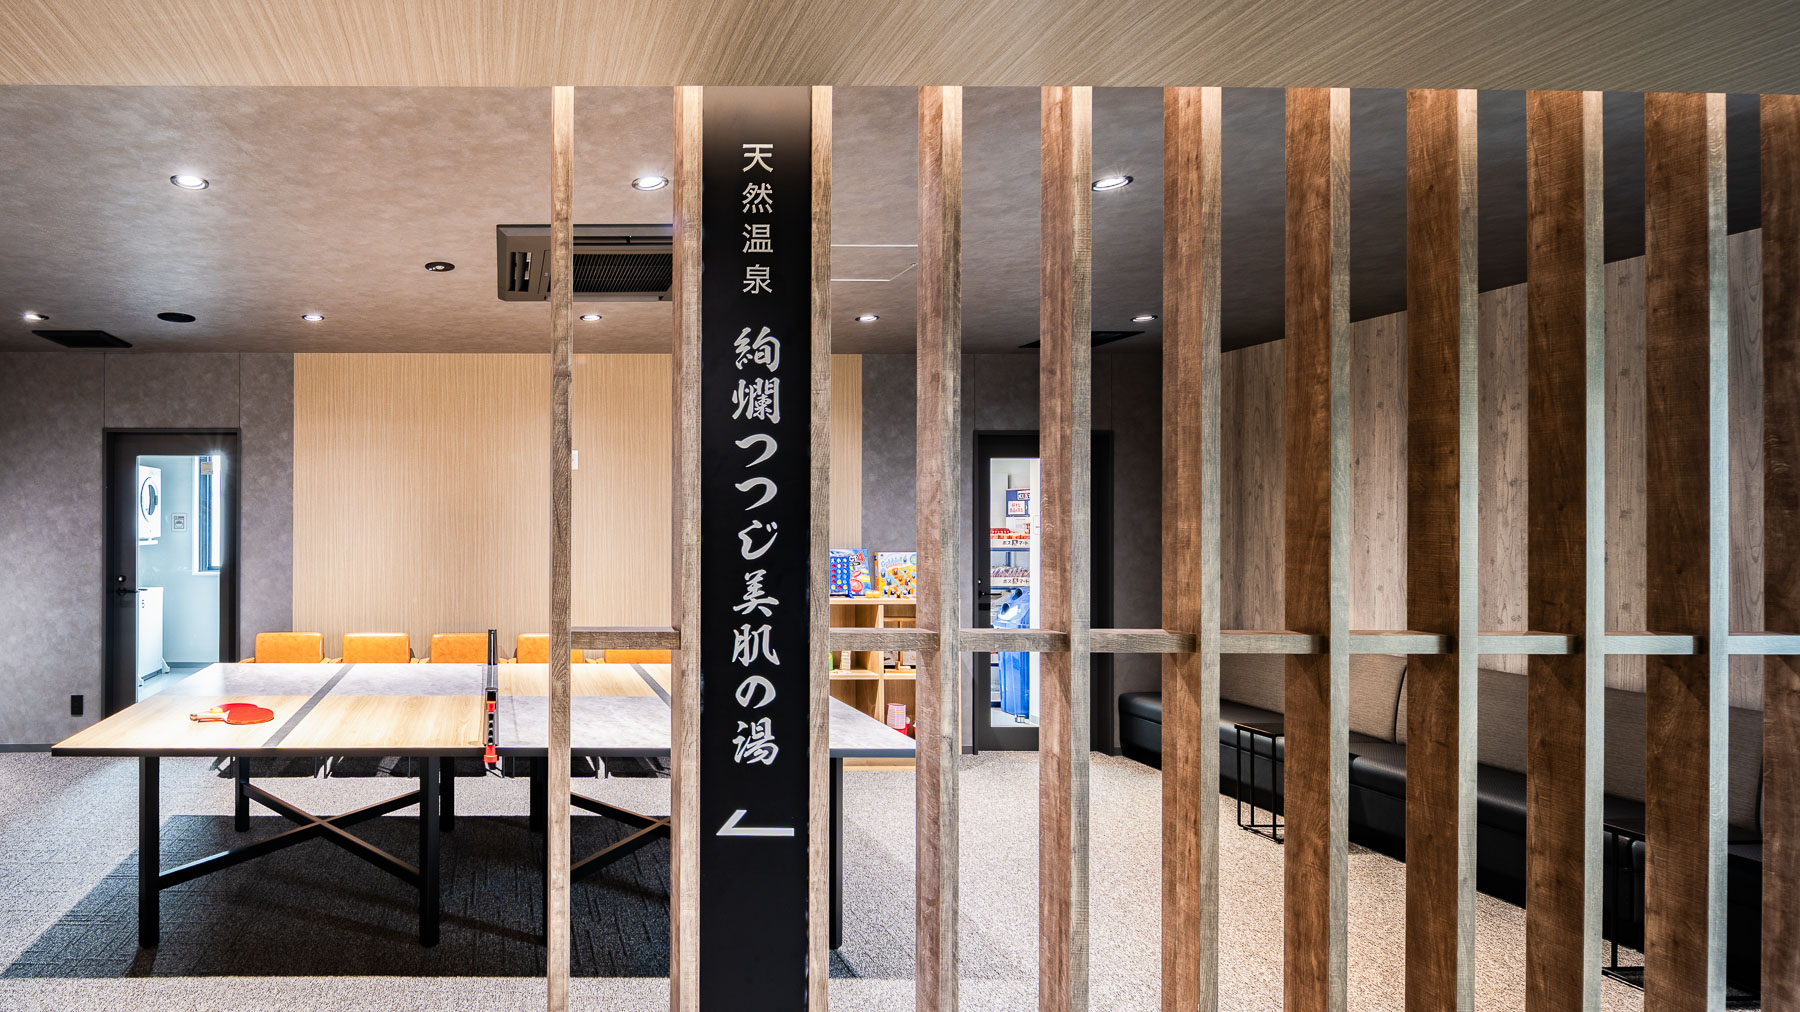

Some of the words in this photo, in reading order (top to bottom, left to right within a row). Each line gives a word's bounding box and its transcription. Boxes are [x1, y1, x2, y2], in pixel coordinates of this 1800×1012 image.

[742, 143, 774, 294] 天然温泉
[731, 326, 781, 766] 絢爛つつじ美肌の湯
